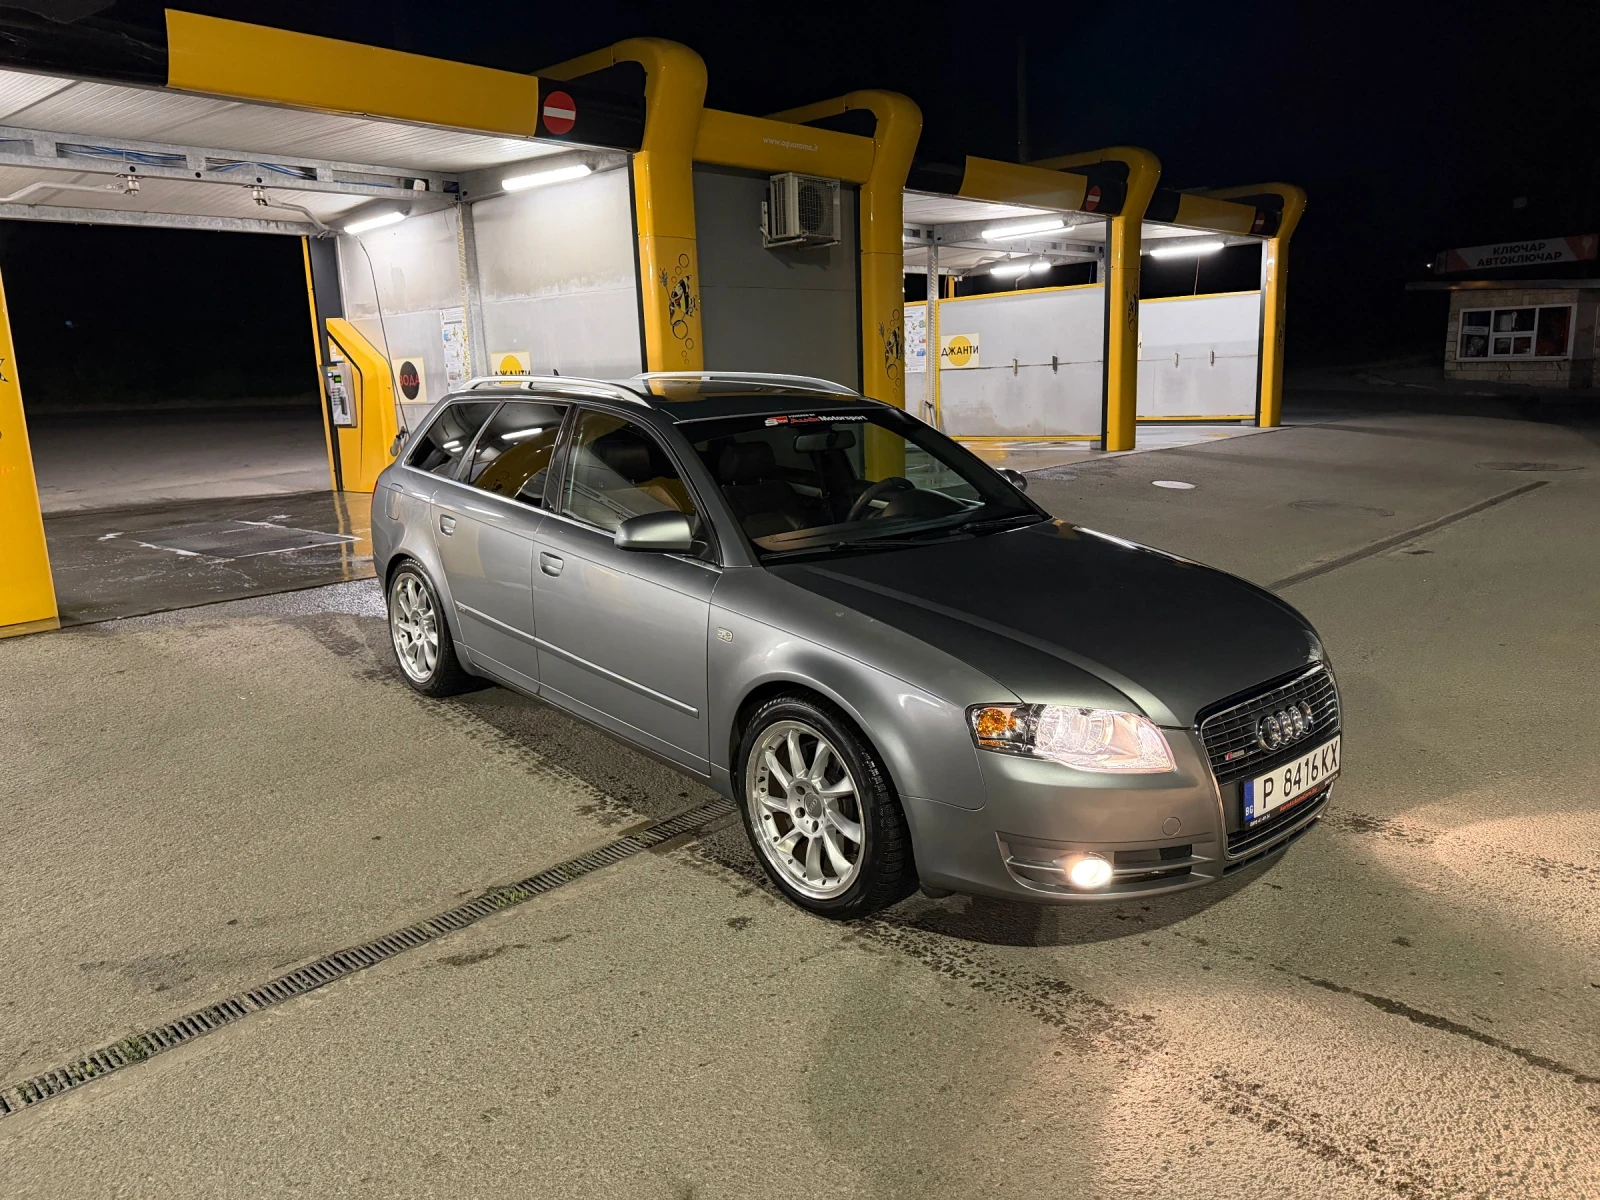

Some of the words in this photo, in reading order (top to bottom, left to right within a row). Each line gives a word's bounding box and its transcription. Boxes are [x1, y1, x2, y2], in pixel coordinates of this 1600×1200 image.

[1493, 242, 1546, 255] КЛЮЧАР
[1477, 251, 1562, 267] АВТОКЛЮЧАР
[941, 345, 979, 357] ДЖАНТИ
[399, 374, 420, 387] ВОДА
[1263, 777, 1274, 809] P
[1283, 753, 1318, 797] 8416
[1321, 740, 1338, 776] KX
[1245, 805, 1254, 816] BG
